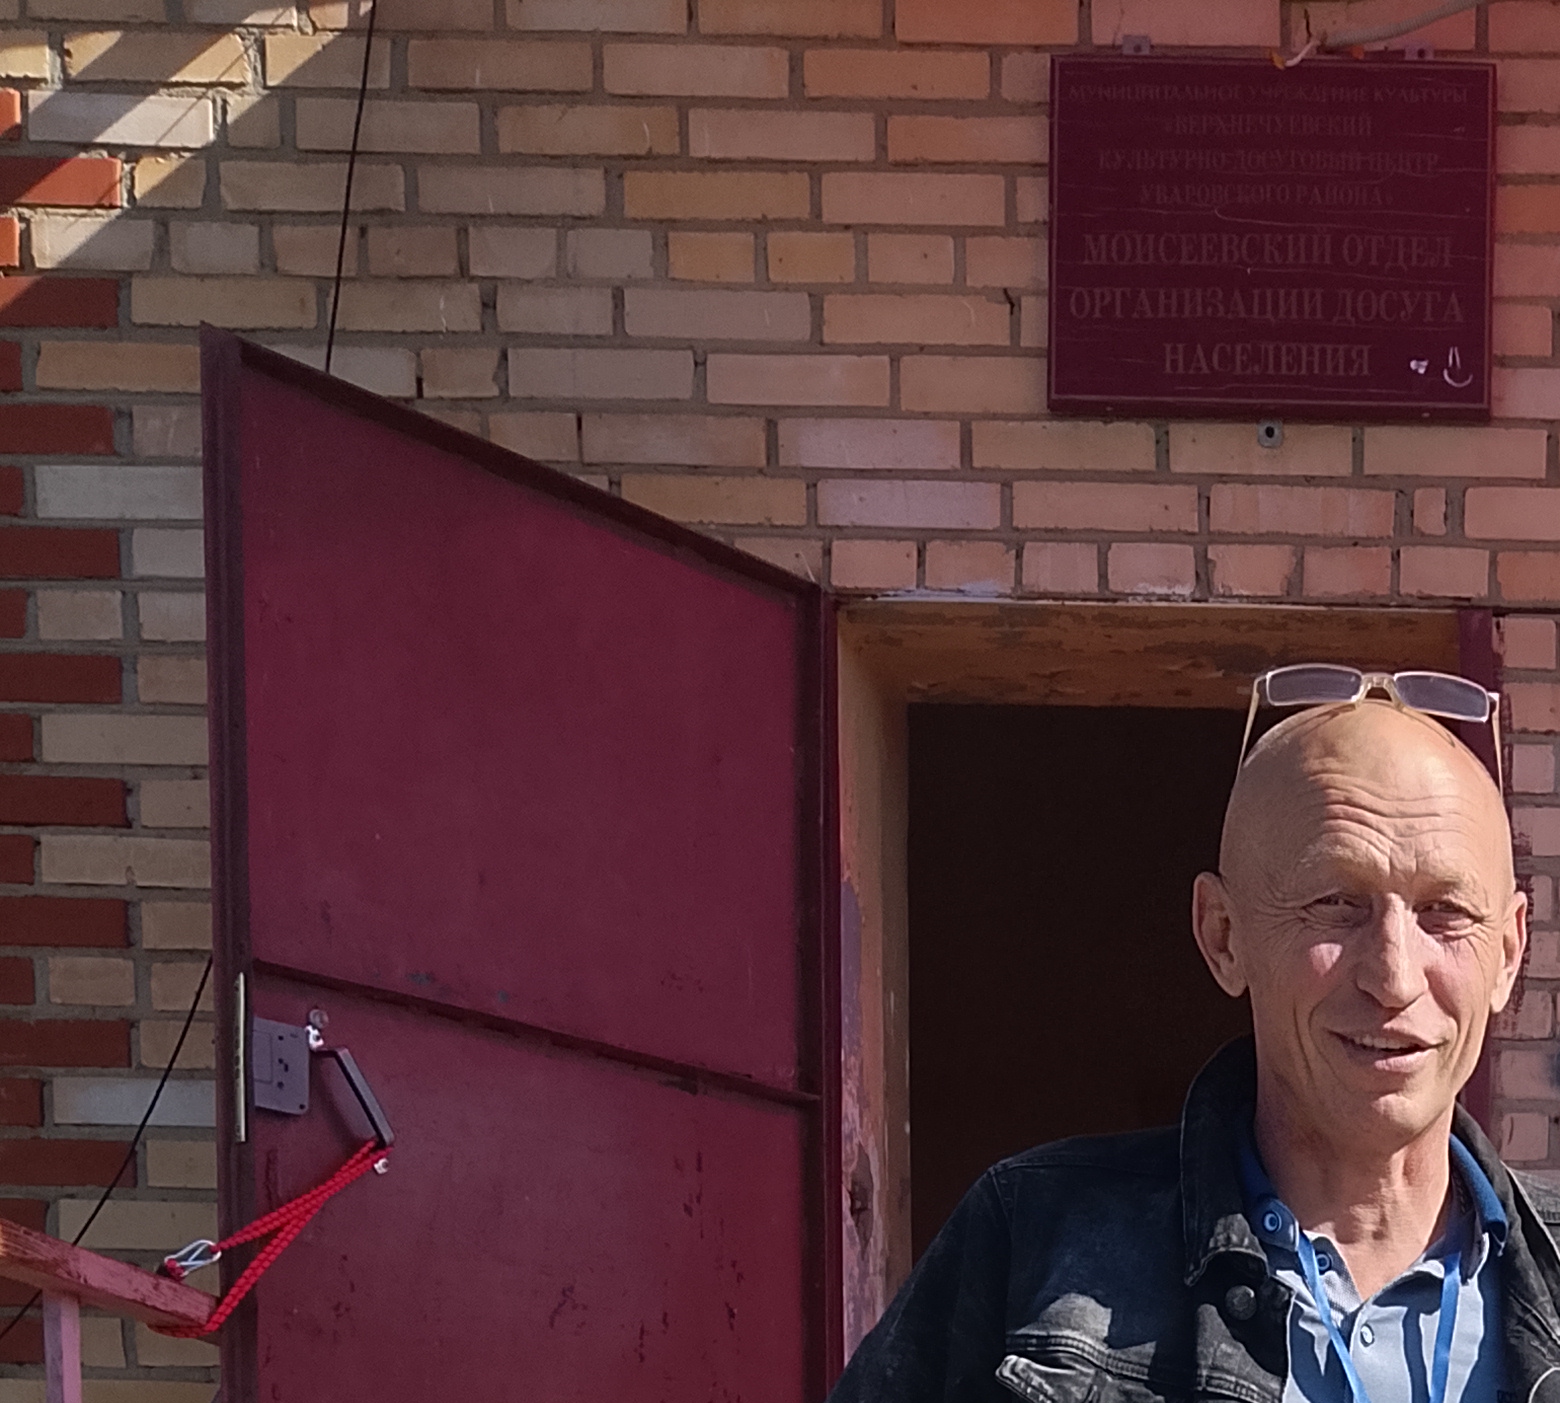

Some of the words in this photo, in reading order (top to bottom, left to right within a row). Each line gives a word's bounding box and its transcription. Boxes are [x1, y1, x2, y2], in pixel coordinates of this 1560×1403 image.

[1082, 228, 1333, 267] МОИСЕЕВСКИЙ
[1341, 233, 1453, 272] ОТДЕЛ
[1068, 286, 1325, 325] ОРГАНИЗАЦИИ
[1332, 288, 1466, 326] ДОСУГА
[1163, 342, 1372, 377] НАСЕЛЕНИЯ
